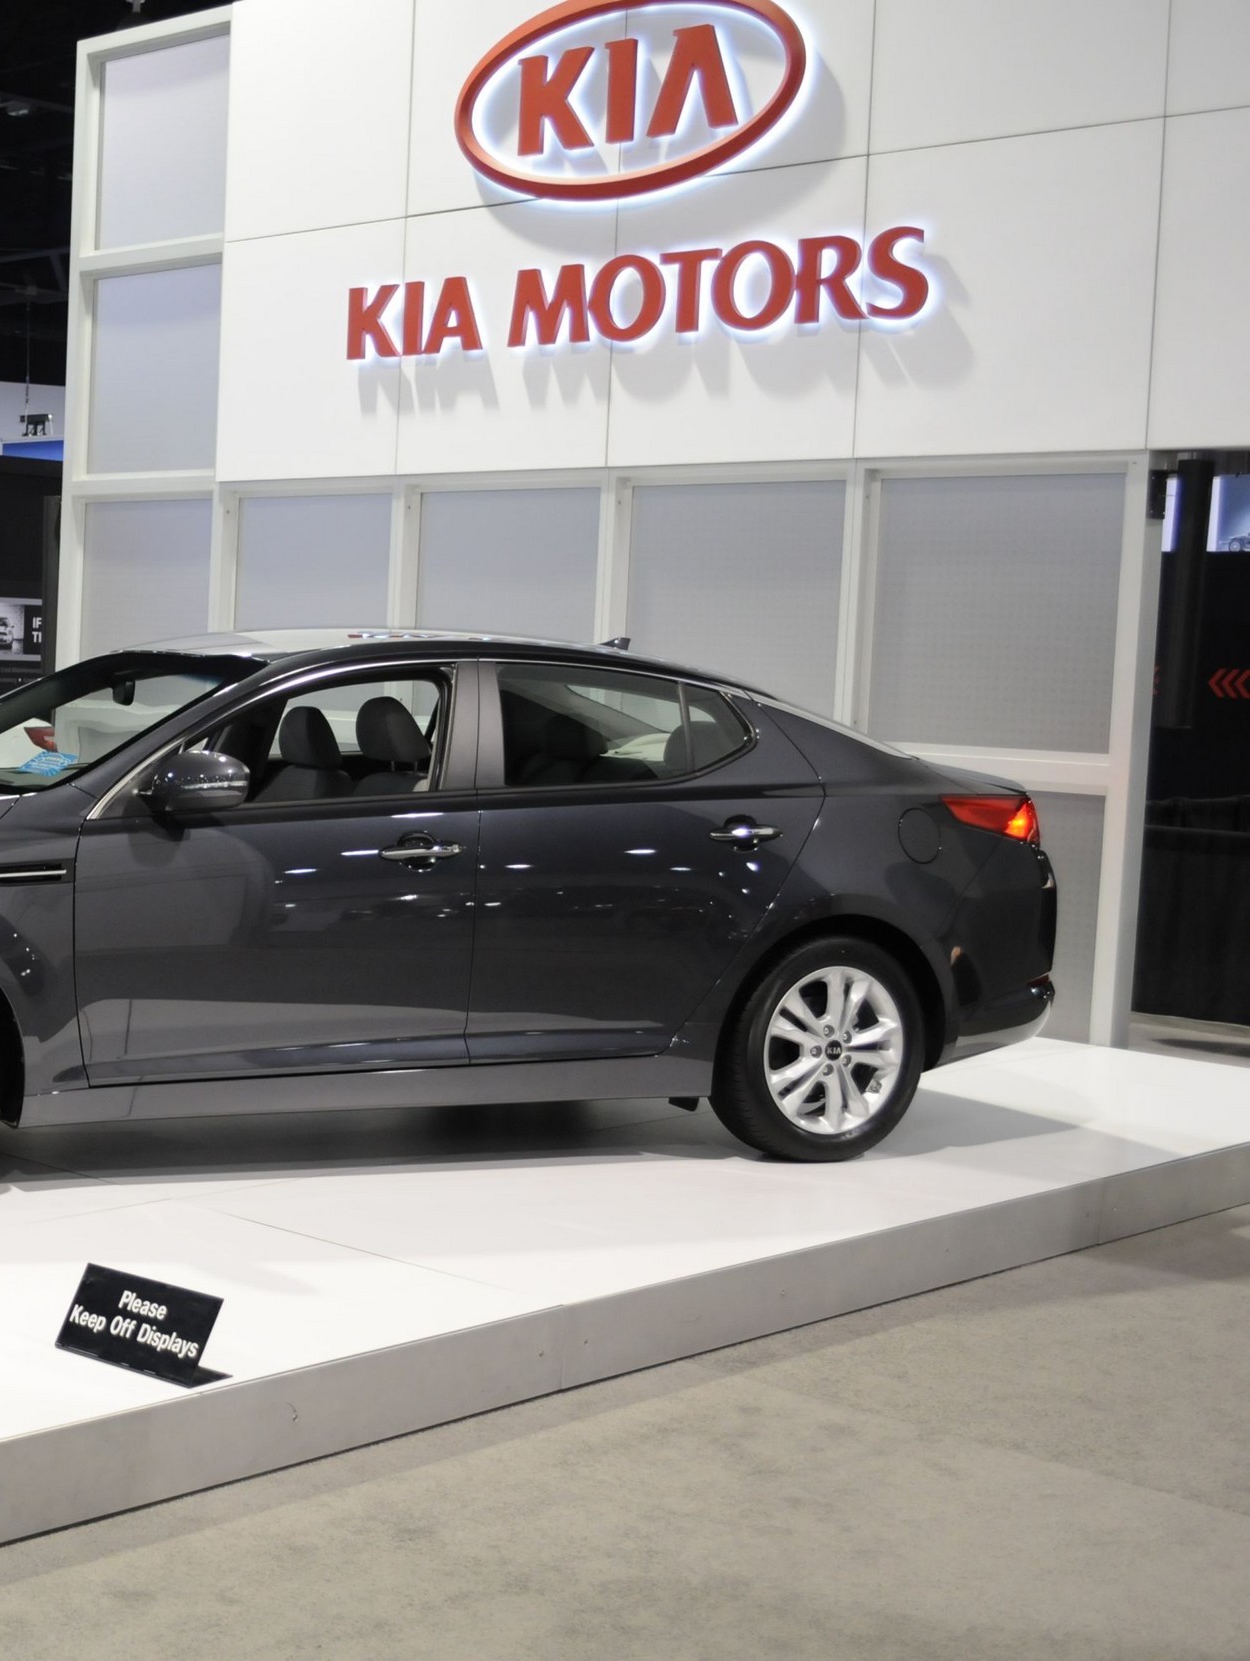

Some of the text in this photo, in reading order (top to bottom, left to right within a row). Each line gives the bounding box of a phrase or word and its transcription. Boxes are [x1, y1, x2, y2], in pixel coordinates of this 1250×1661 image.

[517, 24, 739, 157] KIA
[347, 226, 929, 359] KIA MOTORS
[32, 616, 42, 629] IF
[827, 1046, 841, 1055] KIA
[118, 1290, 168, 1321] Please
[69, 1304, 200, 1359] Keep Off Displays
